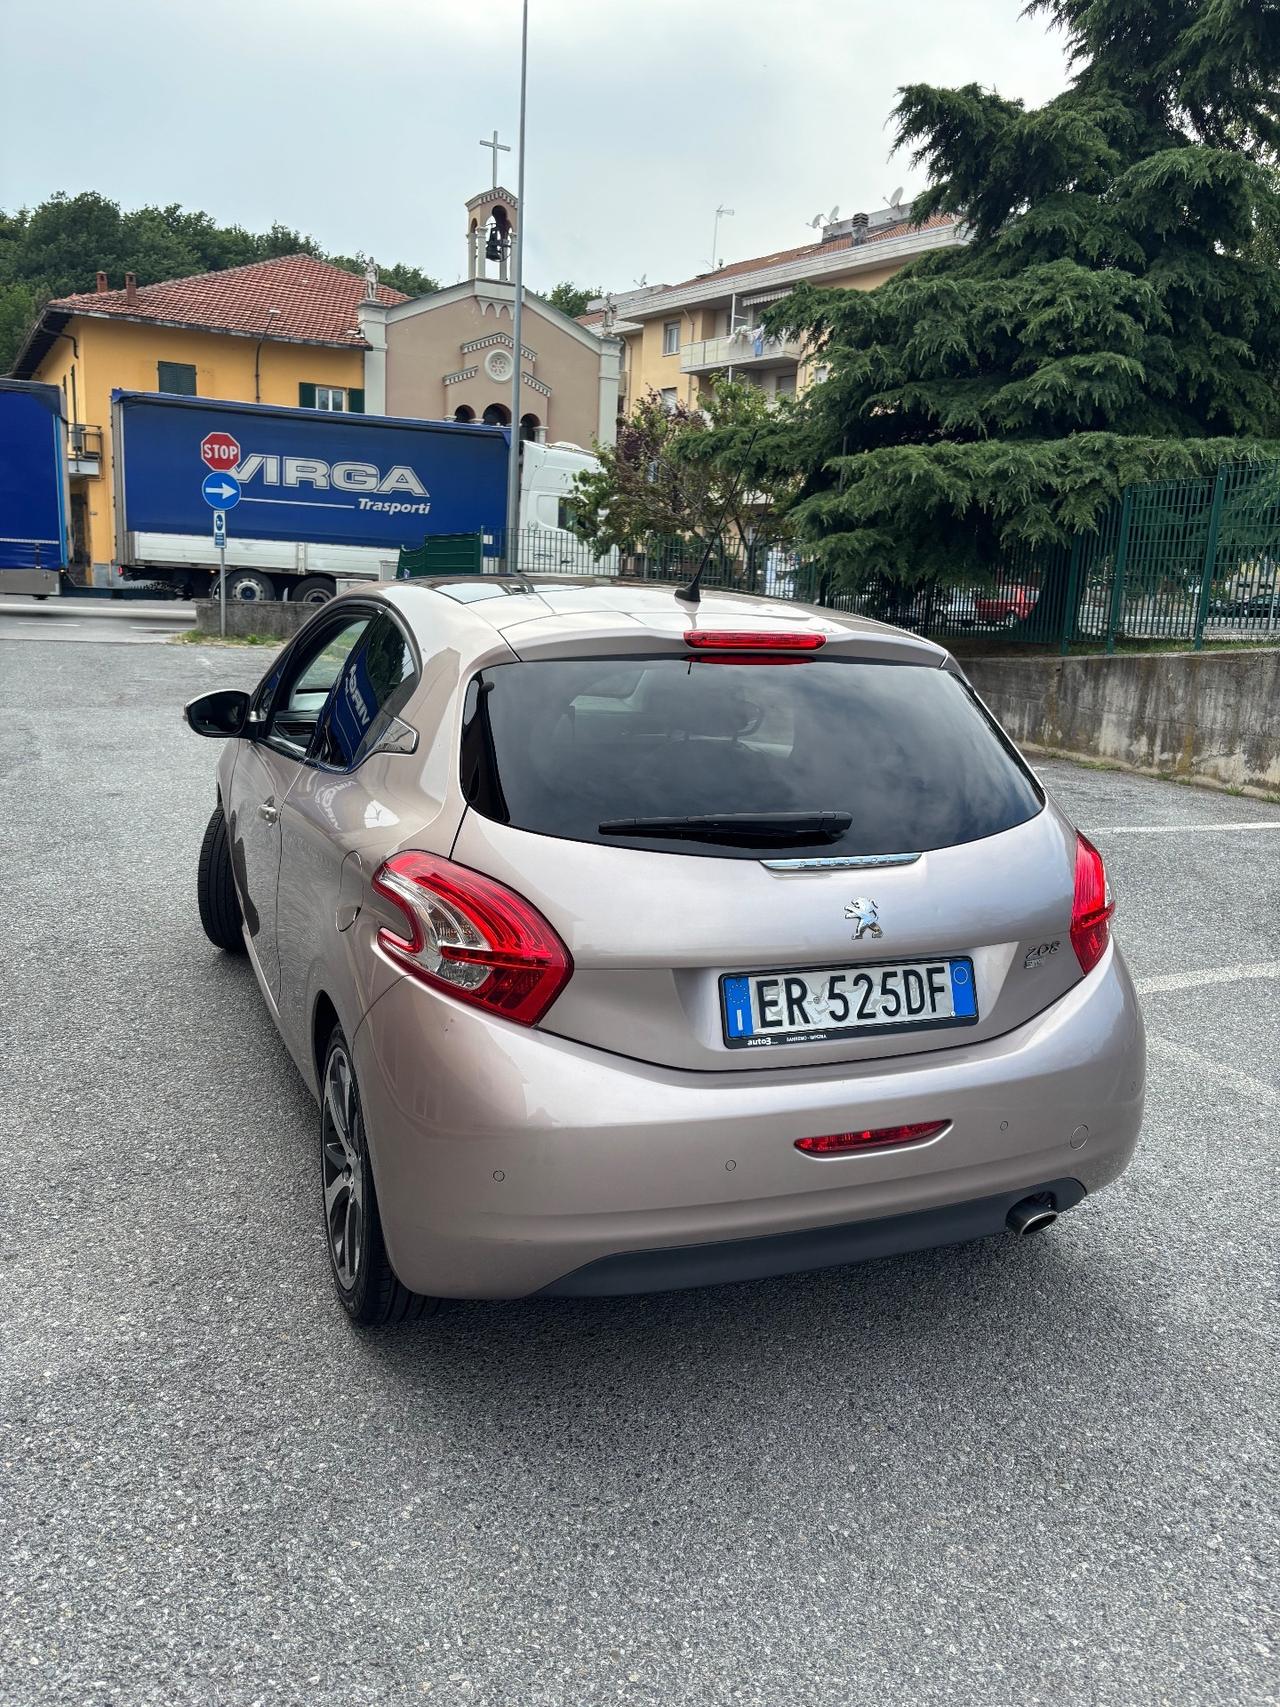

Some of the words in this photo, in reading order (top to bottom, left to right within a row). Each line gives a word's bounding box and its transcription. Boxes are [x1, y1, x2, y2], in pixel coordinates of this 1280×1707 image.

[204, 444, 238, 460] STOP
[229, 453, 430, 498] VIRGA
[358, 498, 431, 515] Trasporti
[756, 977, 811, 1029] ER
[827, 966, 946, 1022] 525DF
